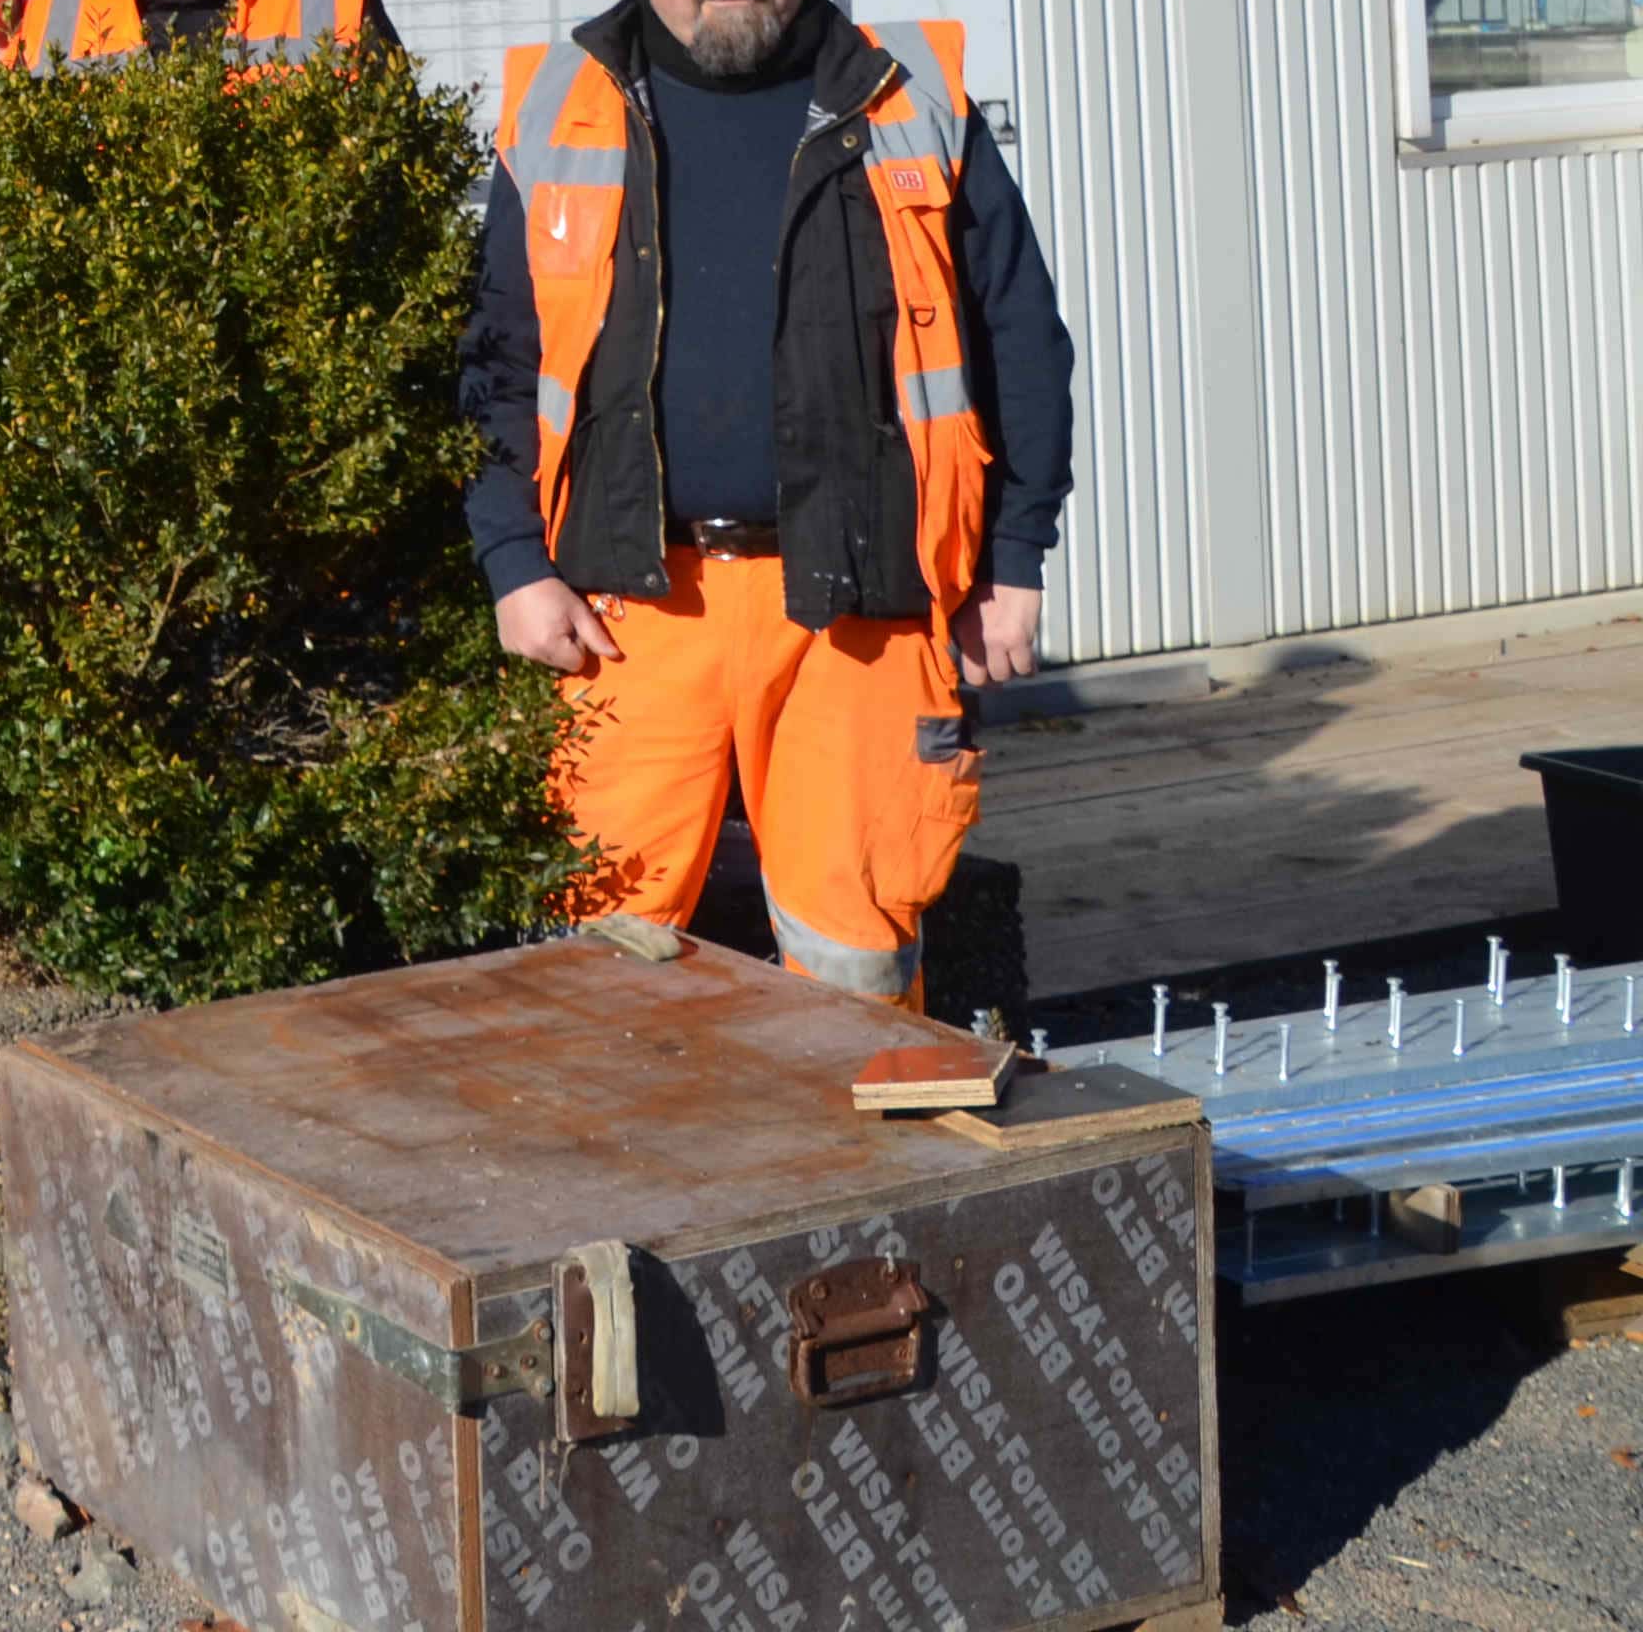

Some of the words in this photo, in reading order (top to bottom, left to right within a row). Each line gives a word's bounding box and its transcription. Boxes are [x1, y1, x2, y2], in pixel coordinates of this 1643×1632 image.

[892, 172, 920, 188] DB
[1092, 1168, 1169, 1287] BETO
[993, 1261, 1073, 1383] BETO
[900, 1393, 975, 1483] BET
[505, 1448, 592, 1570] BETO
[1155, 1443, 1200, 1529] BE
[1060, 1538, 1114, 1607] BE
